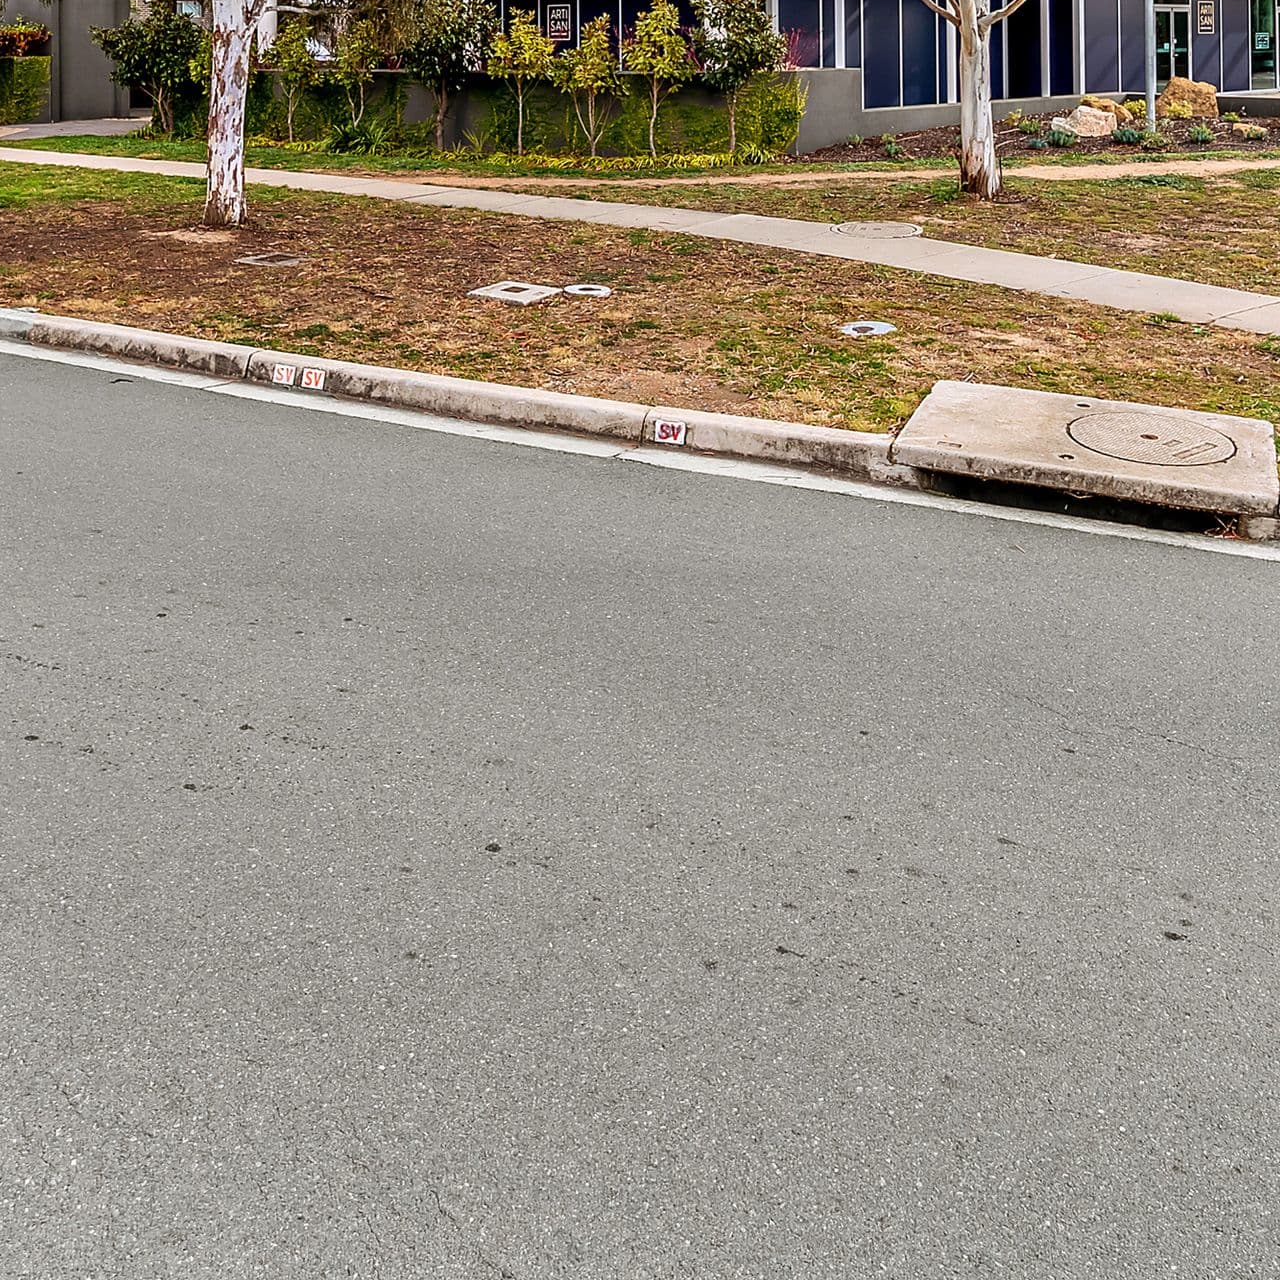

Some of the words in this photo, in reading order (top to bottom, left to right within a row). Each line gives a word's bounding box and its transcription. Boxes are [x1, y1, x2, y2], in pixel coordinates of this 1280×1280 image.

[550, 9, 568, 20] ARTI
[1200, 15, 1213, 26] SAN
[550, 20, 568, 32] SAN
[275, 367, 294, 383] SV
[304, 370, 323, 387] SV
[657, 422, 682, 441] SV
